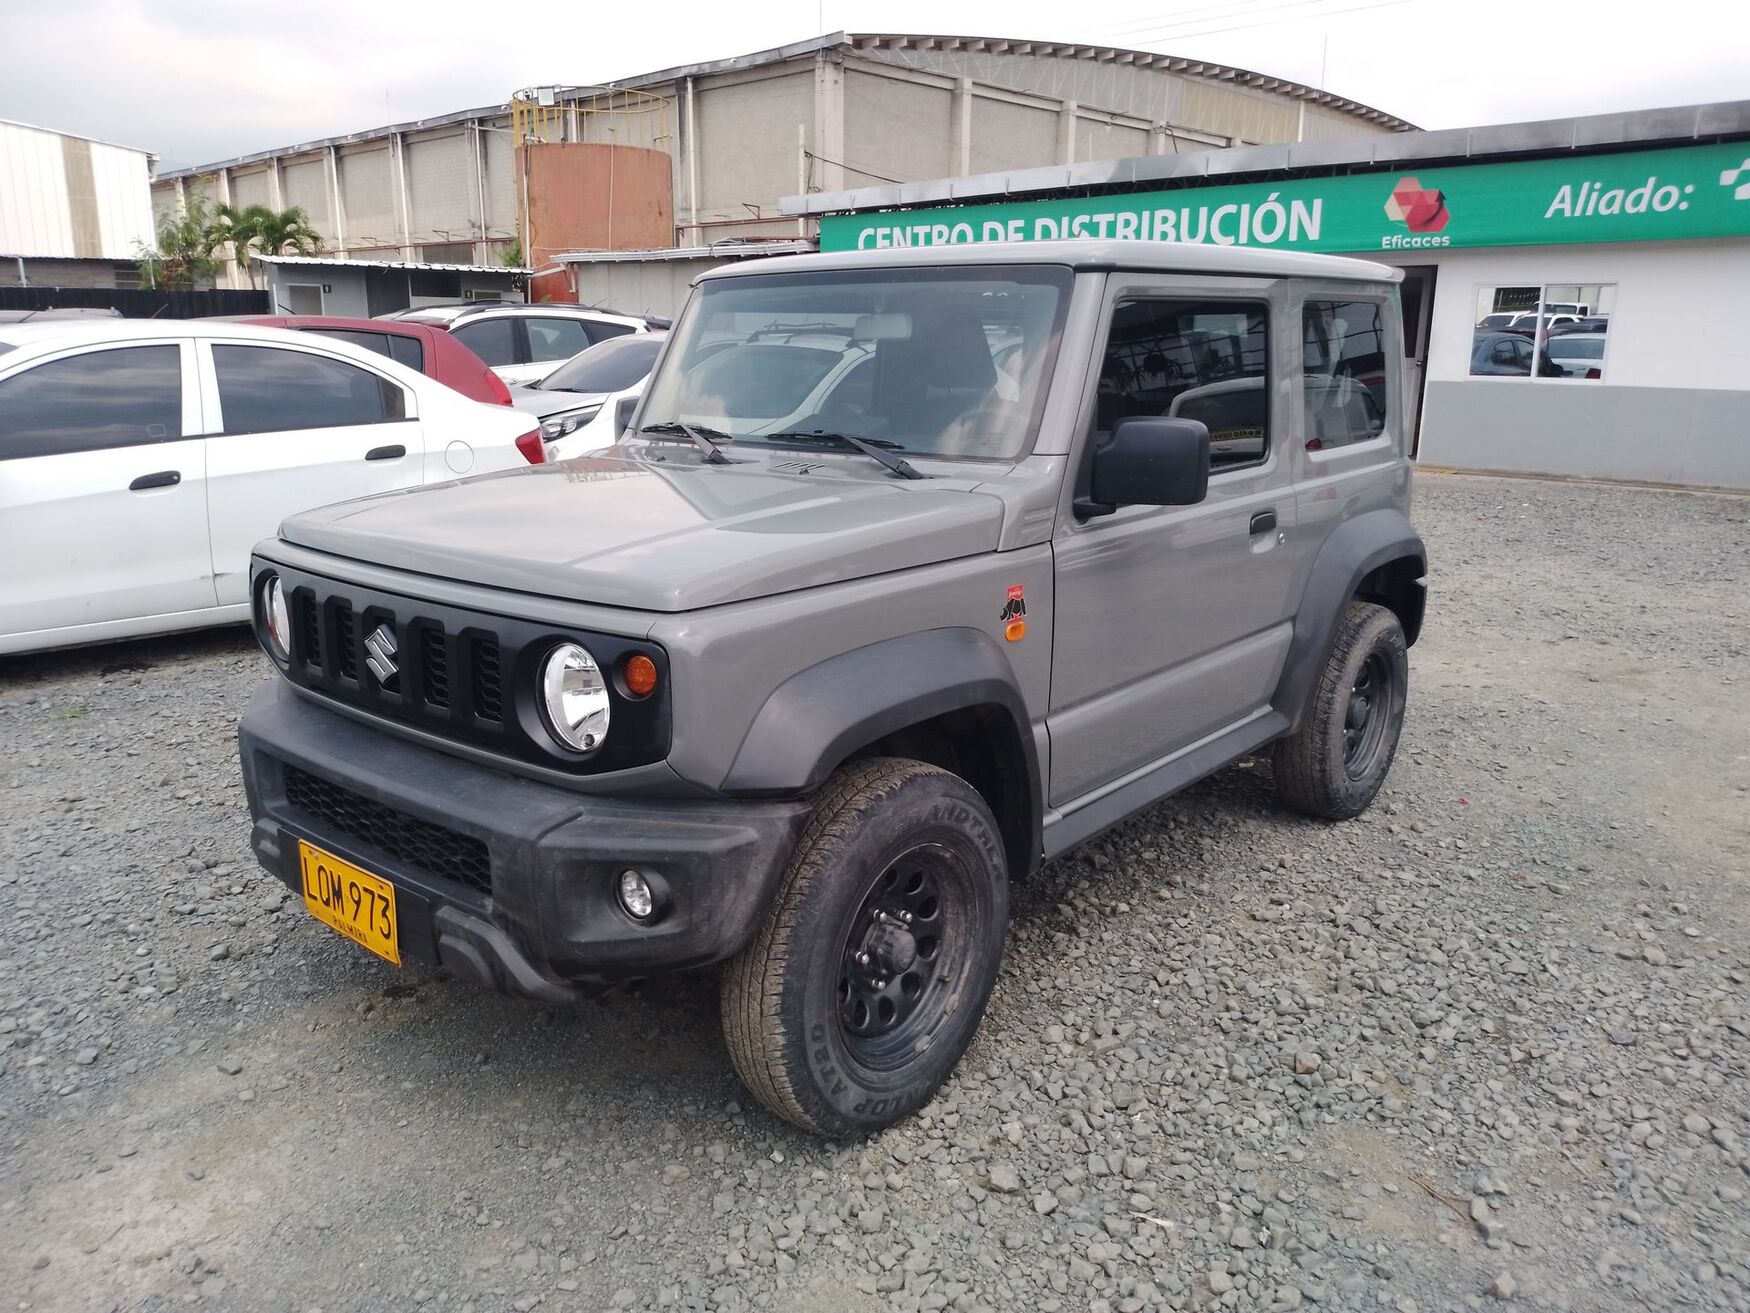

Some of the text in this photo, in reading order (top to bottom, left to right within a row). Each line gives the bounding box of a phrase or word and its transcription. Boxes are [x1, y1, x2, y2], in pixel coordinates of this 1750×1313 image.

[857, 192, 1323, 249] CENTRO DE DISTRIBUCIÓN
[1545, 176, 1694, 219] Aliado:
[1381, 234, 1450, 249] Eficaces
[349, 881, 392, 941] 973
